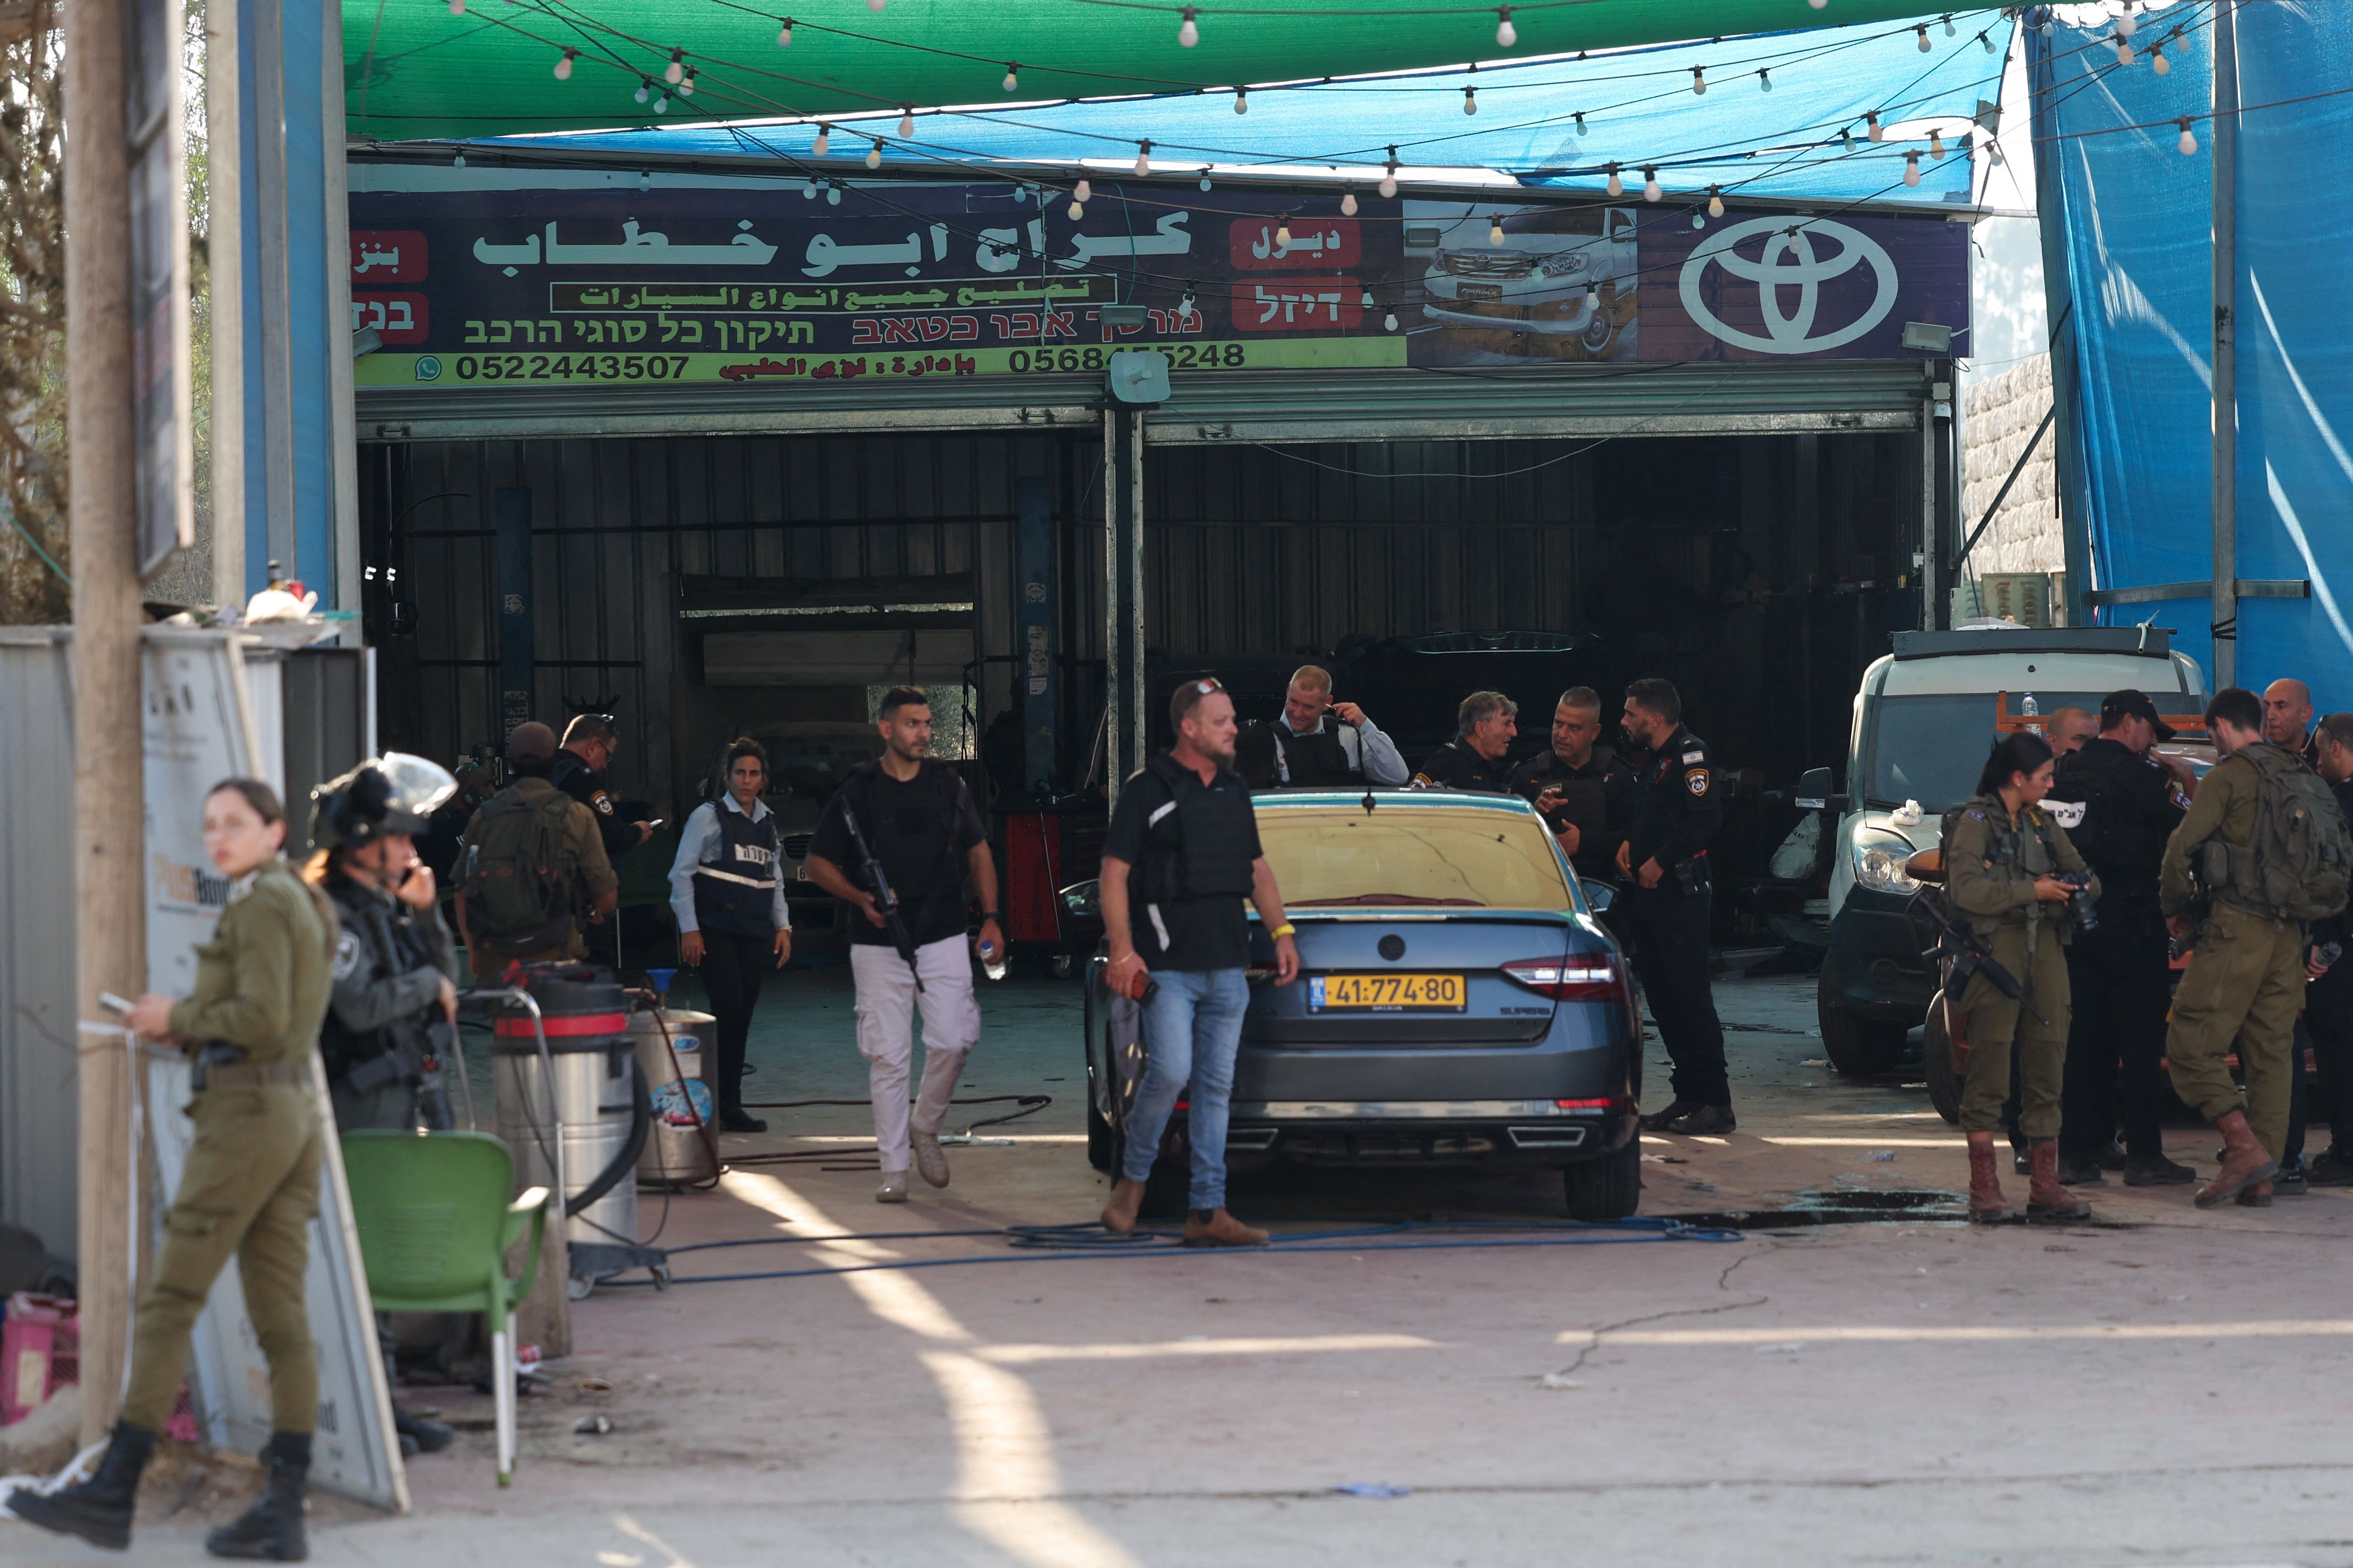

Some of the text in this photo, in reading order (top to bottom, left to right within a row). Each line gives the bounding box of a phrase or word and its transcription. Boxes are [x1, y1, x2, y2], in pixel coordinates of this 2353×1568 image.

[353, 242, 399, 274] بنز
[473, 211, 1191, 278] كراج ابو خطاب
[579, 281, 1089, 311] تصليح جميع انواع السيارات
[1255, 285, 1342, 323] דיזל
[351, 301, 414, 330] בנז
[852, 315, 979, 344] כטאב
[990, 311, 1077, 339] אבו
[464, 312, 814, 351] תיקון כל סוגי הרכב
[456, 356, 689, 380] 0522443507
[1009, 343, 1245, 372] 05685248
